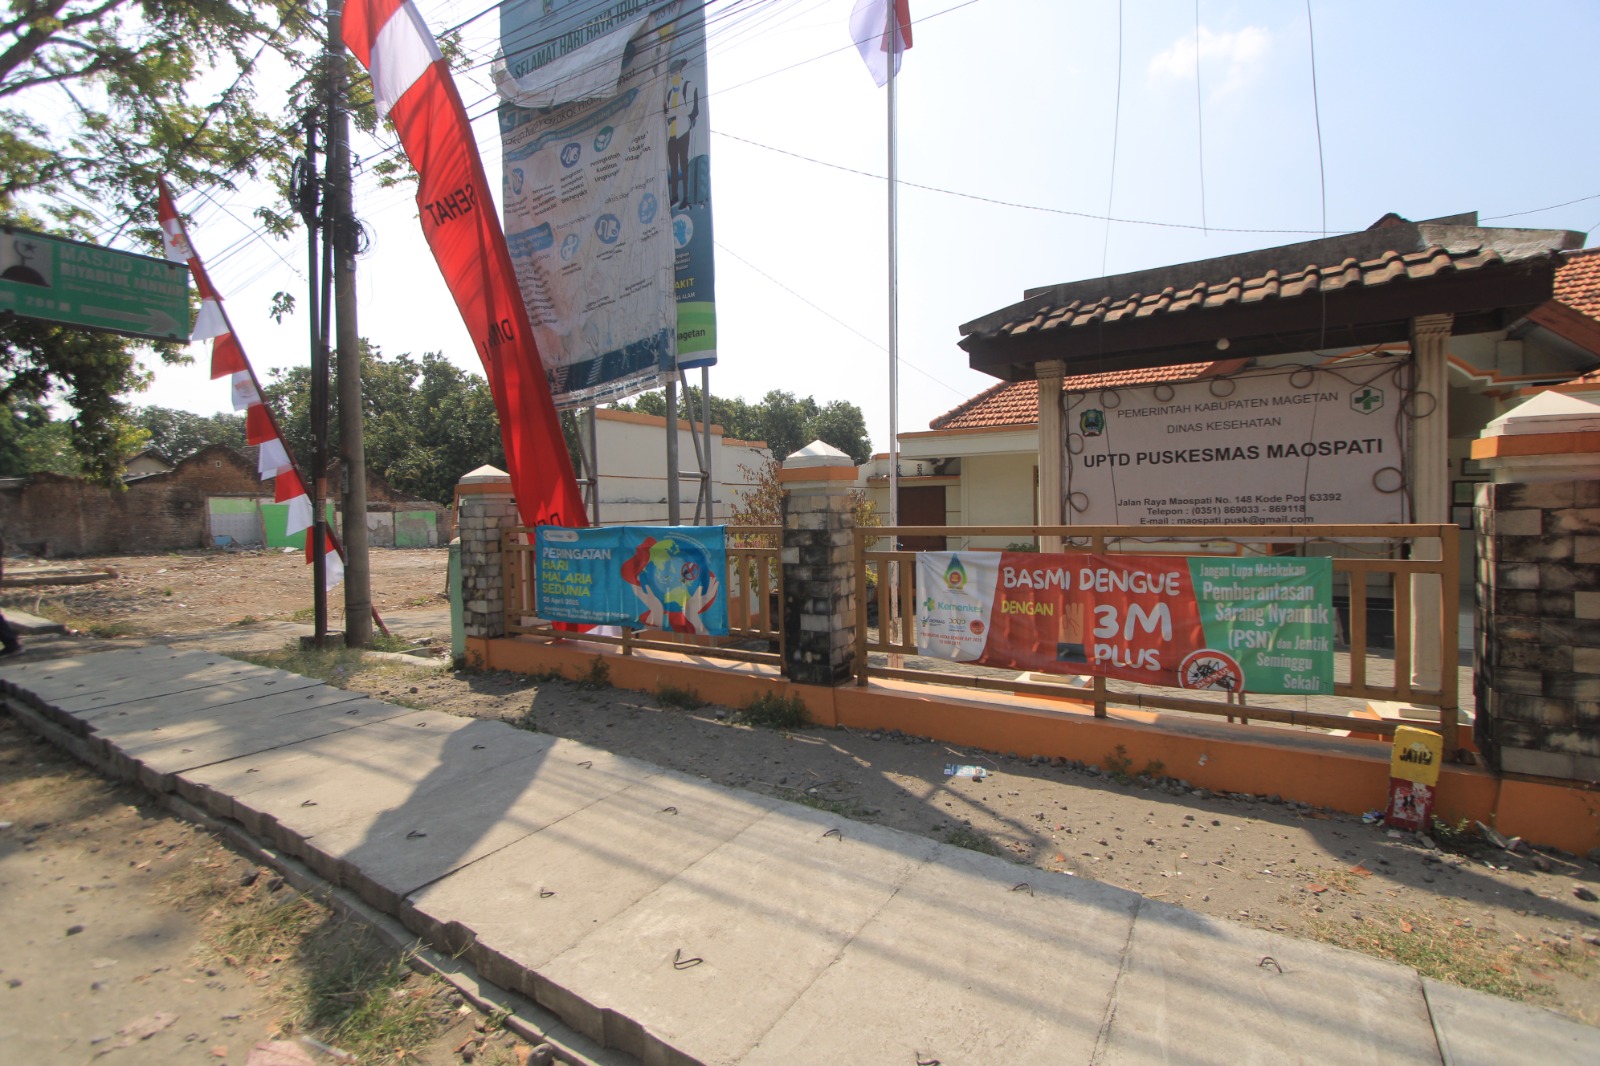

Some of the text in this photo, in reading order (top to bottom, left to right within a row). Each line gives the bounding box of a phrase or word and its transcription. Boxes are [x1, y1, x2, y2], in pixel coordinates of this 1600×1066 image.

[515, 43, 557, 79] SELAMAT
[560, 27, 585, 57] HARI
[586, 13, 613, 42] RAYA
[60, 246, 132, 273] MASJID
[1117, 392, 1339, 418] PEMERINTAH KABUPATEN MAGETAN
[1167, 417, 1282, 434] DINAS KESEHATAN
[1084, 438, 1383, 468] UPTD PUSKESMAS MAOSPATI
[1118, 499, 1142, 507] Jalan
[1144, 499, 1167, 507] Raya
[1169, 497, 1212, 507] Maospati
[1286, 494, 1306, 502] Pos
[1309, 493, 1342, 501] 63392
[1147, 507, 1183, 516] Telepon
[1191, 506, 1221, 515] (0351)
[1224, 505, 1259, 514] 869033
[1269, 504, 1306, 513] 869118
[1140, 517, 1169, 525] E-mail
[542, 547, 612, 560] PERINGATAN
[542, 560, 568, 571] HARI
[1200, 563, 1306, 579] Jangan Lupa Melakukan
[542, 571, 592, 585] MALARIA
[1003, 566, 1180, 596] BASMI DENGUE
[542, 583, 591, 597] SEDUNIA
[1203, 581, 1314, 601] Pemberantasan
[937, 601, 984, 613] Kemenkes
[1001, 600, 1054, 616] DENGAN
[1215, 602, 1329, 627] Sarang Nyamuk
[1093, 602, 1173, 642] 3M
[1229, 628, 1329, 651] (PSN) dan Jentik
[1094, 643, 1161, 671] PLUS
[1256, 652, 1313, 672] Seminggu
[1284, 674, 1320, 690] Sekali
